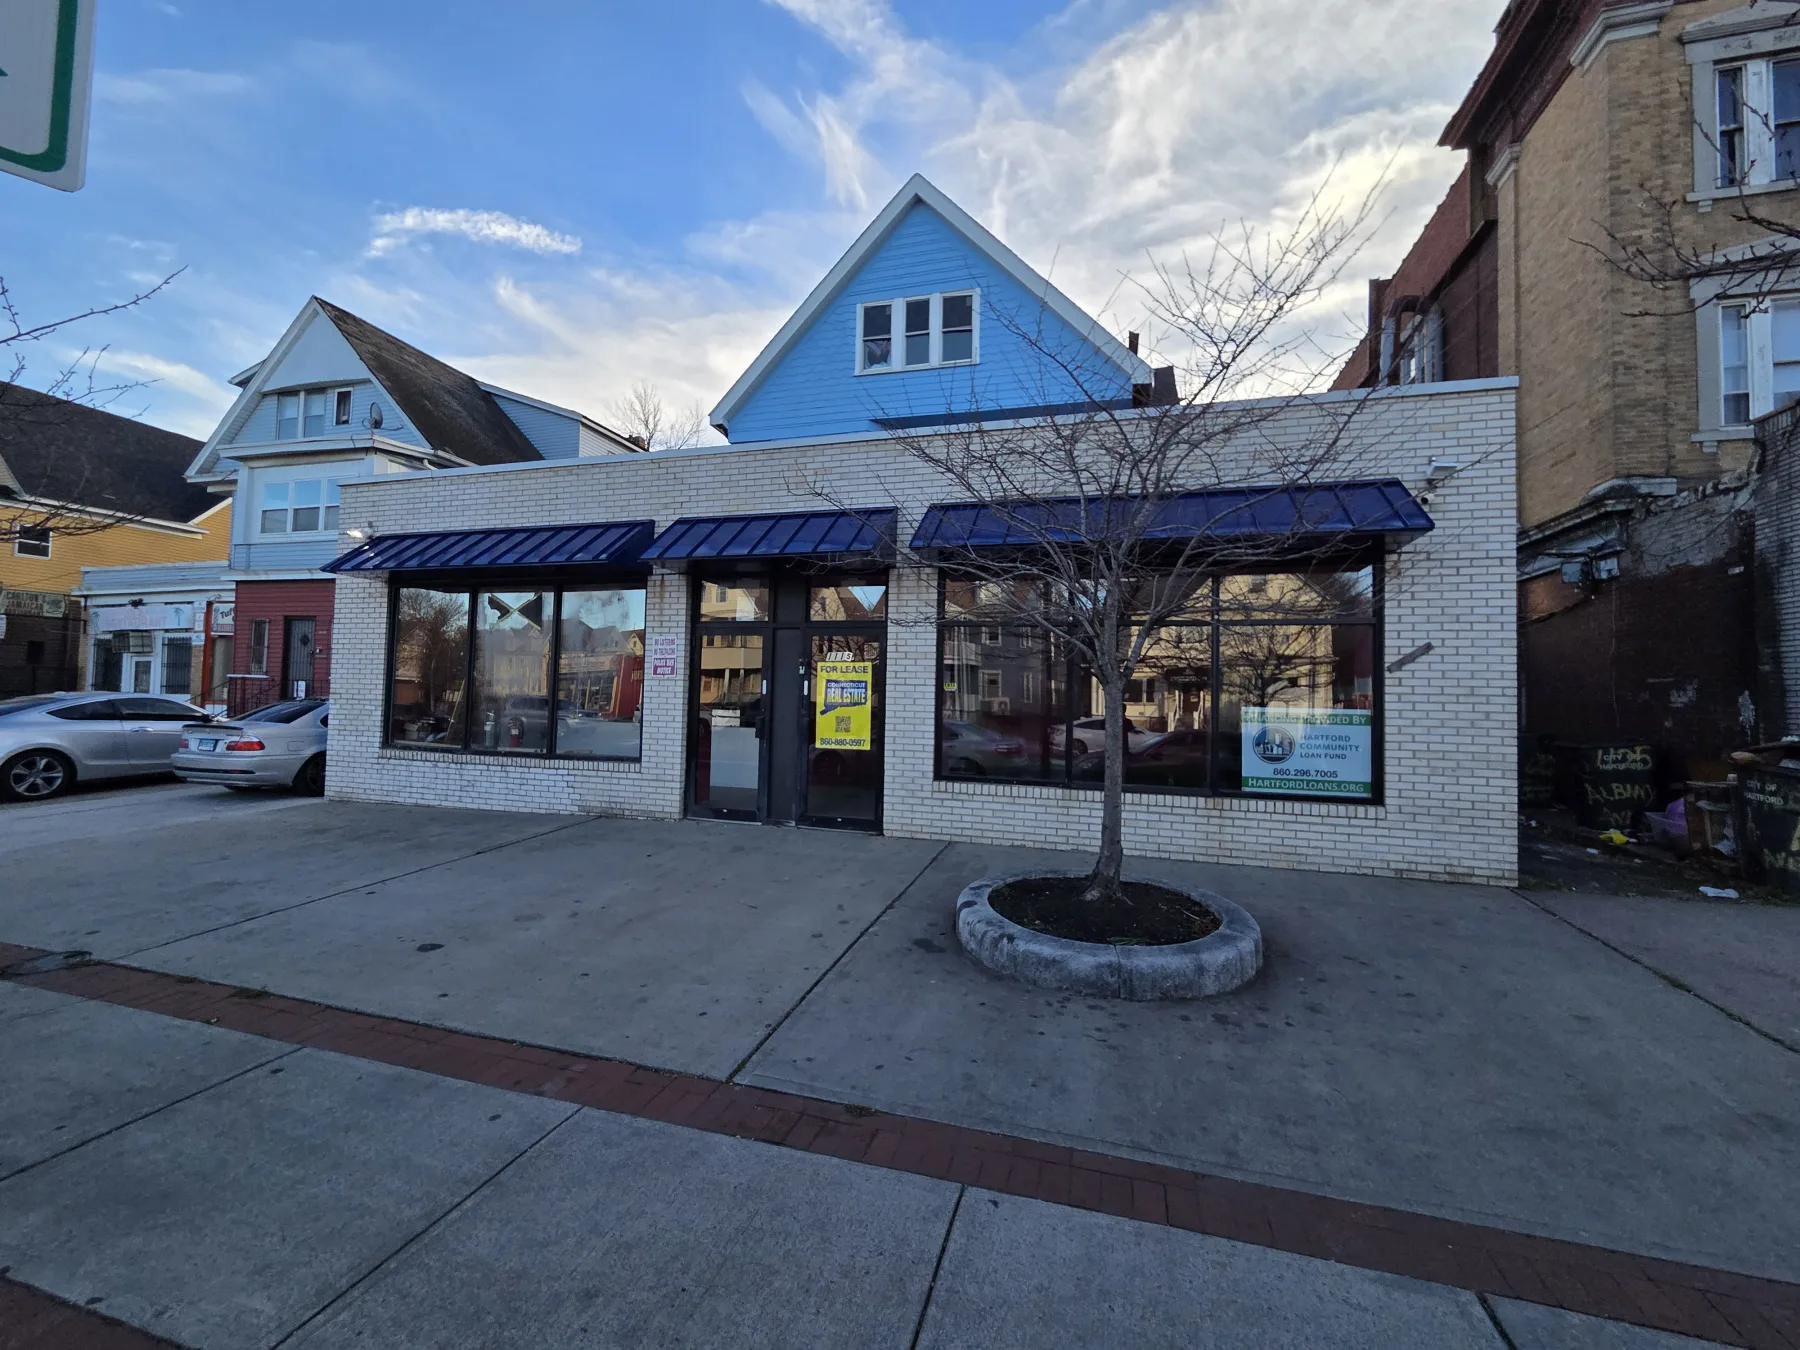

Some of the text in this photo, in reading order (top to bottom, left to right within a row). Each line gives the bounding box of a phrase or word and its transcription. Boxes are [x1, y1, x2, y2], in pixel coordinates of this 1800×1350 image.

[8, 600, 44, 611] JAMAICAN
[820, 666, 868, 674] FOR LEASE
[827, 688, 866, 703] REAL ESTATE
[1353, 715, 1367, 724] BY
[1300, 734, 1351, 742] HARTFORD
[1300, 743, 1360, 752] COMMUNITY
[1273, 768, 1338, 778] 860.296.7005
[1746, 780, 1777, 792] CITY OF
[1743, 791, 1784, 805] HARTFORD
